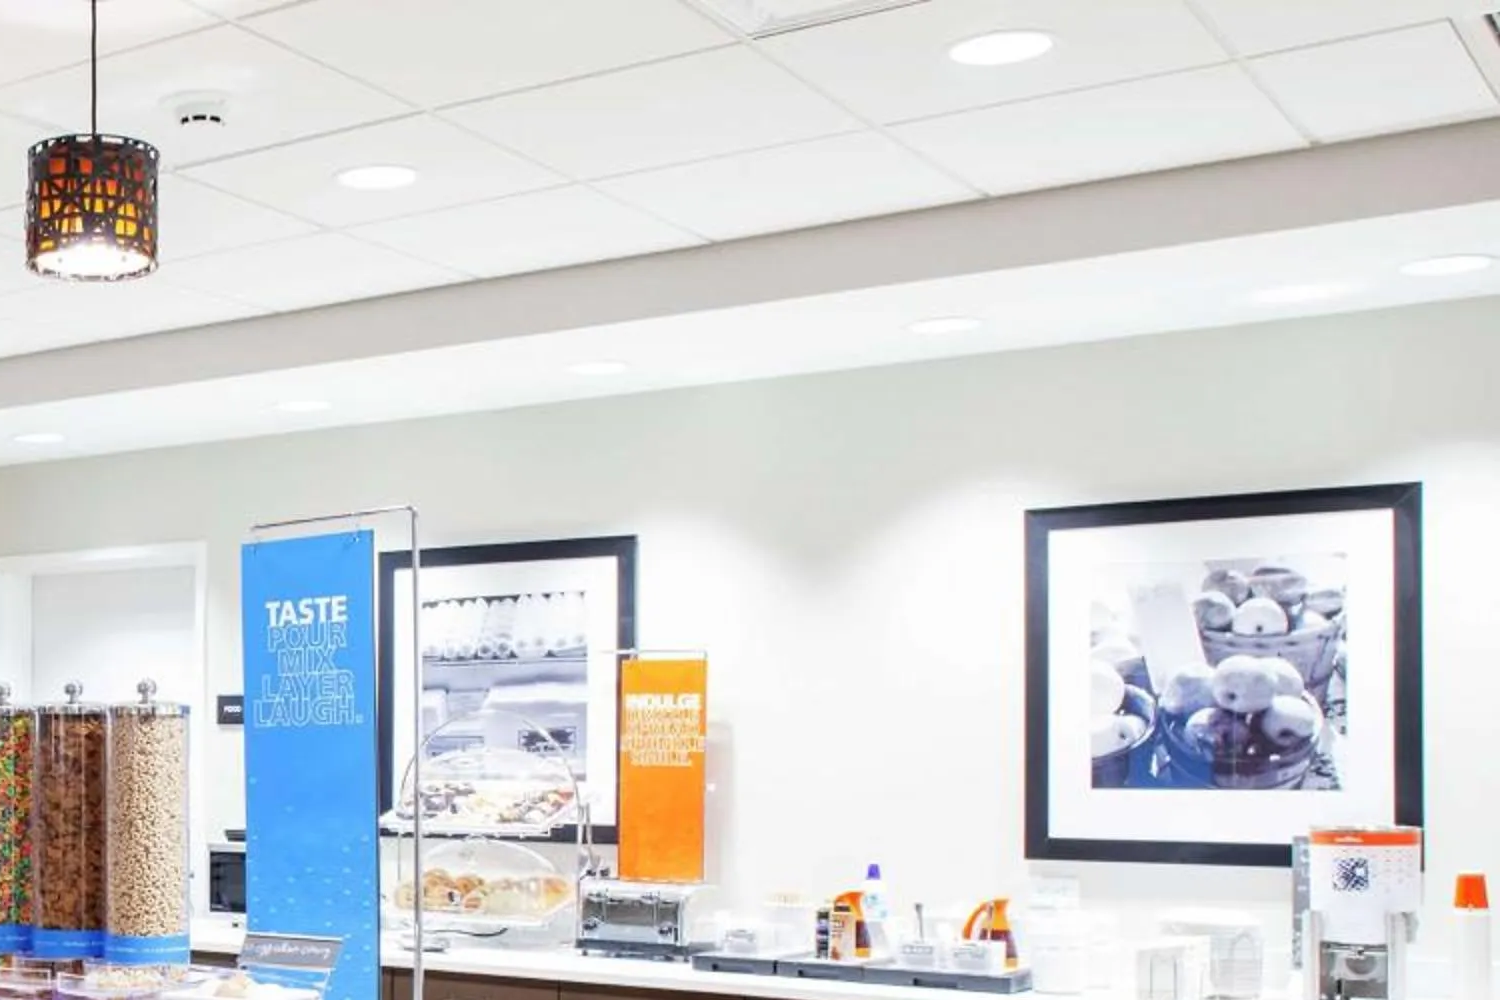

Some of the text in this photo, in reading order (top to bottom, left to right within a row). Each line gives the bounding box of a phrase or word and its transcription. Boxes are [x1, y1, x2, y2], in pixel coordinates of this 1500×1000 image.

[265, 595, 348, 628] TASTE
[266, 621, 347, 653] POUR
[277, 647, 337, 677] MIX
[261, 668, 355, 702] LAYER
[253, 696, 365, 729] LAUGH.
